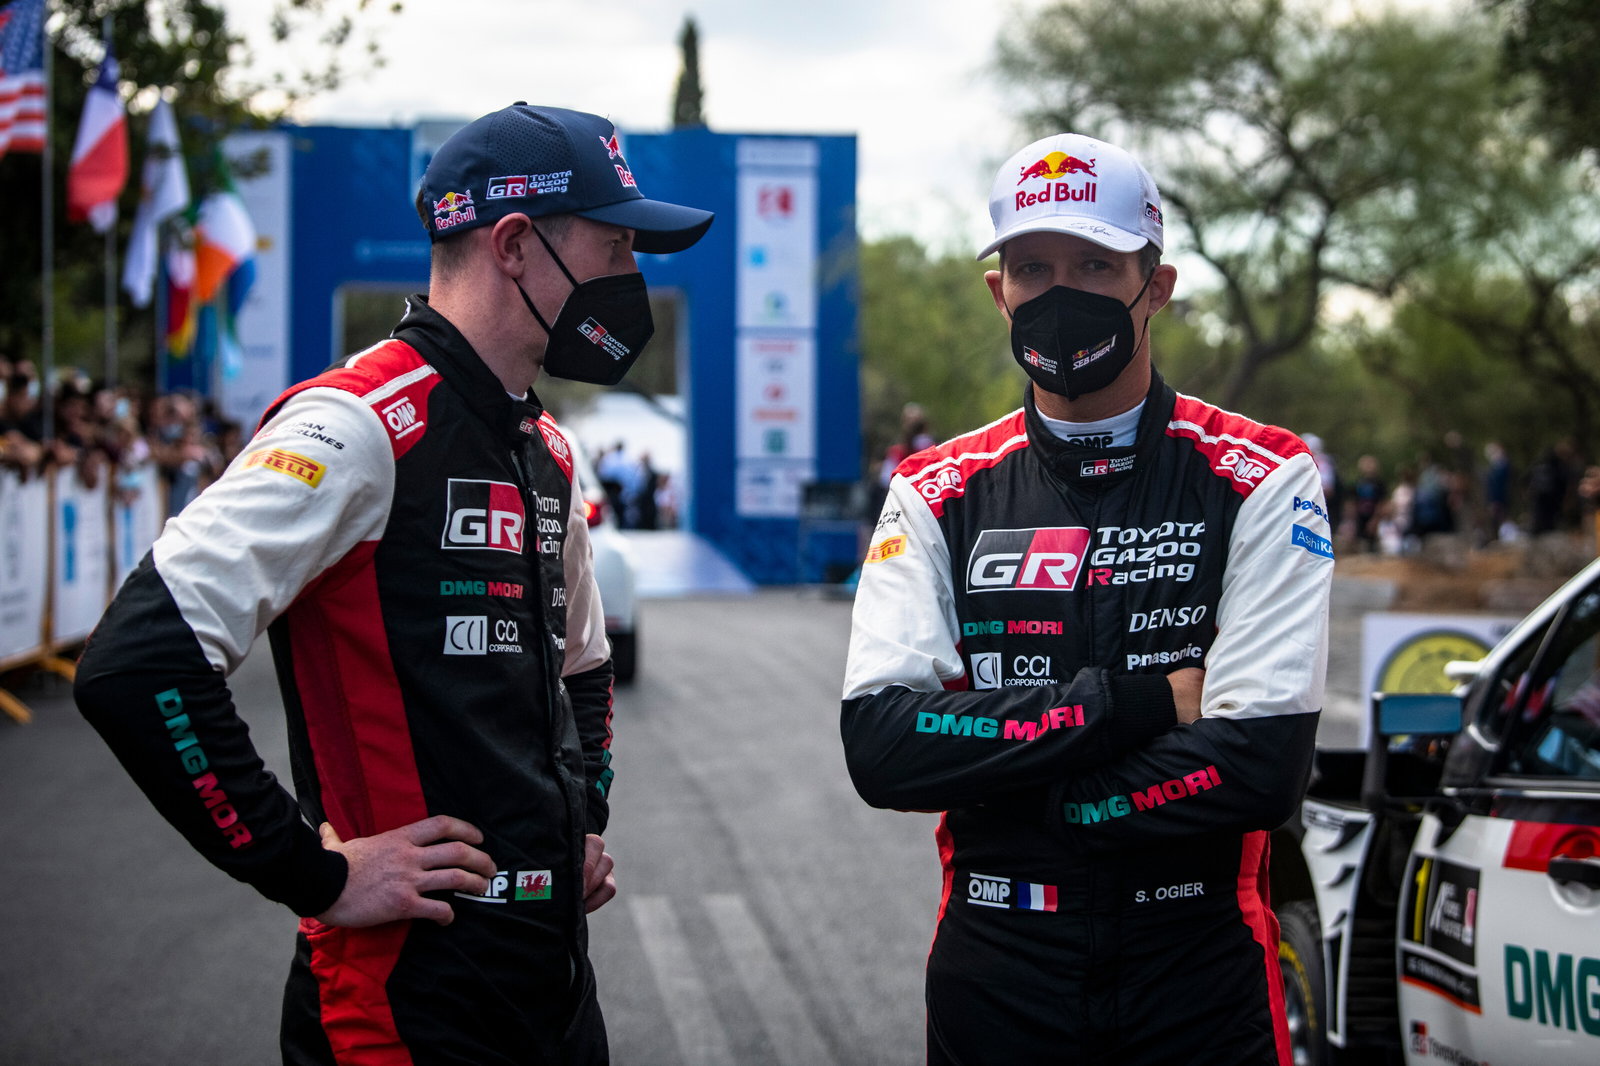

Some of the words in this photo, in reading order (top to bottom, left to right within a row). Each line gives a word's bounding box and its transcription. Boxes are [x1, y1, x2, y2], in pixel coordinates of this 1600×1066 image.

[529, 178, 569, 188] GAZOO
[530, 170, 573, 182] TOYOTA
[489, 183, 525, 197] GR
[528, 186, 568, 194] Racing
[1015, 183, 1051, 211] Red
[1054, 182, 1097, 202] Bull
[435, 211, 457, 231] Red
[454, 205, 477, 225] Bull
[580, 323, 601, 341] GR
[601, 337, 625, 356] GAZOO
[605, 334, 630, 354] TOYOTA
[1024, 352, 1038, 367] GR
[1038, 354, 1058, 366] TOYOTA
[1073, 356, 1090, 370] SEB
[387, 402, 417, 432] OMP
[519, 420, 533, 433] GR
[1108, 464, 1133, 473] Racing
[1109, 454, 1136, 464] TOYOTA
[1109, 459, 1134, 468] GAZOO
[1220, 452, 1266, 480] OMP
[1082, 465, 1107, 475] GR
[921, 470, 962, 499] OMP
[448, 508, 523, 549] GR
[1096, 521, 1206, 545] TOYOTA
[1090, 541, 1201, 566] GAZOO
[970, 552, 1078, 586] GR
[1087, 562, 1195, 586] Racing
[440, 581, 486, 596] DMG
[487, 581, 524, 599] MORI
[963, 620, 1004, 637] DMG
[1007, 620, 1063, 635] MORI
[1128, 605, 1207, 633] DENSO
[495, 620, 518, 642] CCI
[489, 643, 523, 653] CORPORATION
[1013, 655, 1051, 677] CCI
[915, 711, 999, 738] DMG
[155, 687, 209, 775] DMG
[192, 771, 255, 849] MOR
[1063, 794, 1132, 825] DMG
[1131, 765, 1223, 812] MORI
[968, 879, 1011, 903] OMP
[1135, 890, 1150, 903] S.
[1155, 882, 1205, 901] OGIER
[1504, 943, 1600, 1038] DMG
